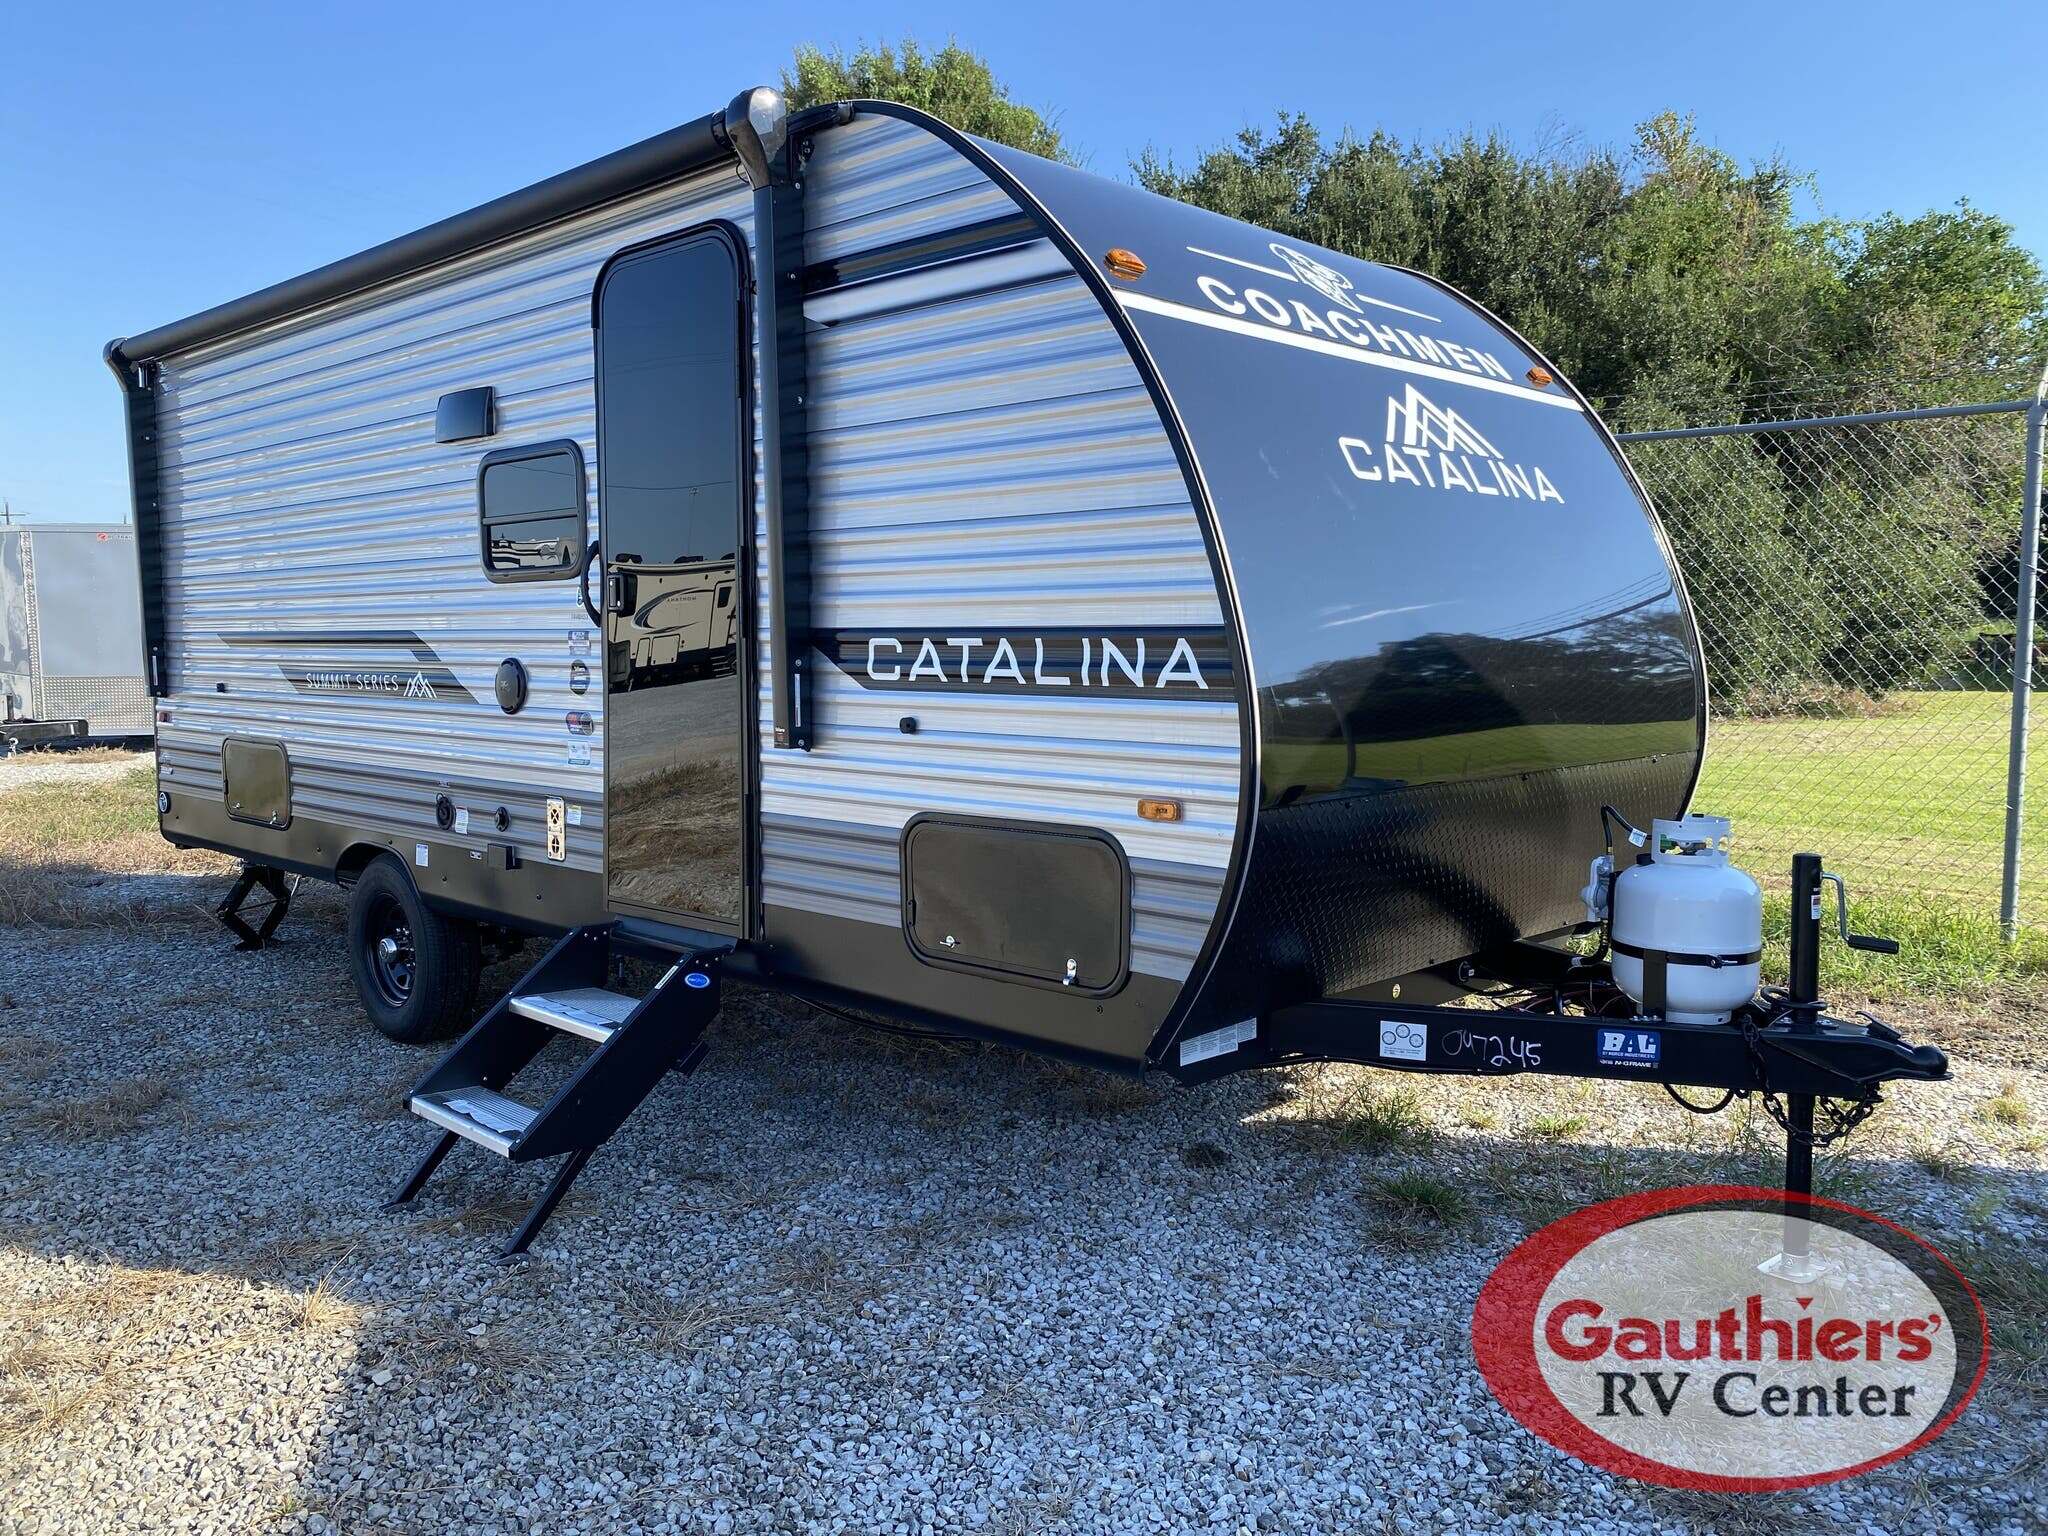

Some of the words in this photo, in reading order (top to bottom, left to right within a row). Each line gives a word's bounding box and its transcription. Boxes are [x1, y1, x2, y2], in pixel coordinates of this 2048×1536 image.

[1196, 274, 1513, 381] COACHMEN
[1338, 436, 1565, 504] CATALINA
[305, 673, 351, 689] SUMMIT
[355, 674, 399, 691] SERIES
[866, 637, 1209, 690] CATALINA
[1603, 1032, 1656, 1053] BAL
